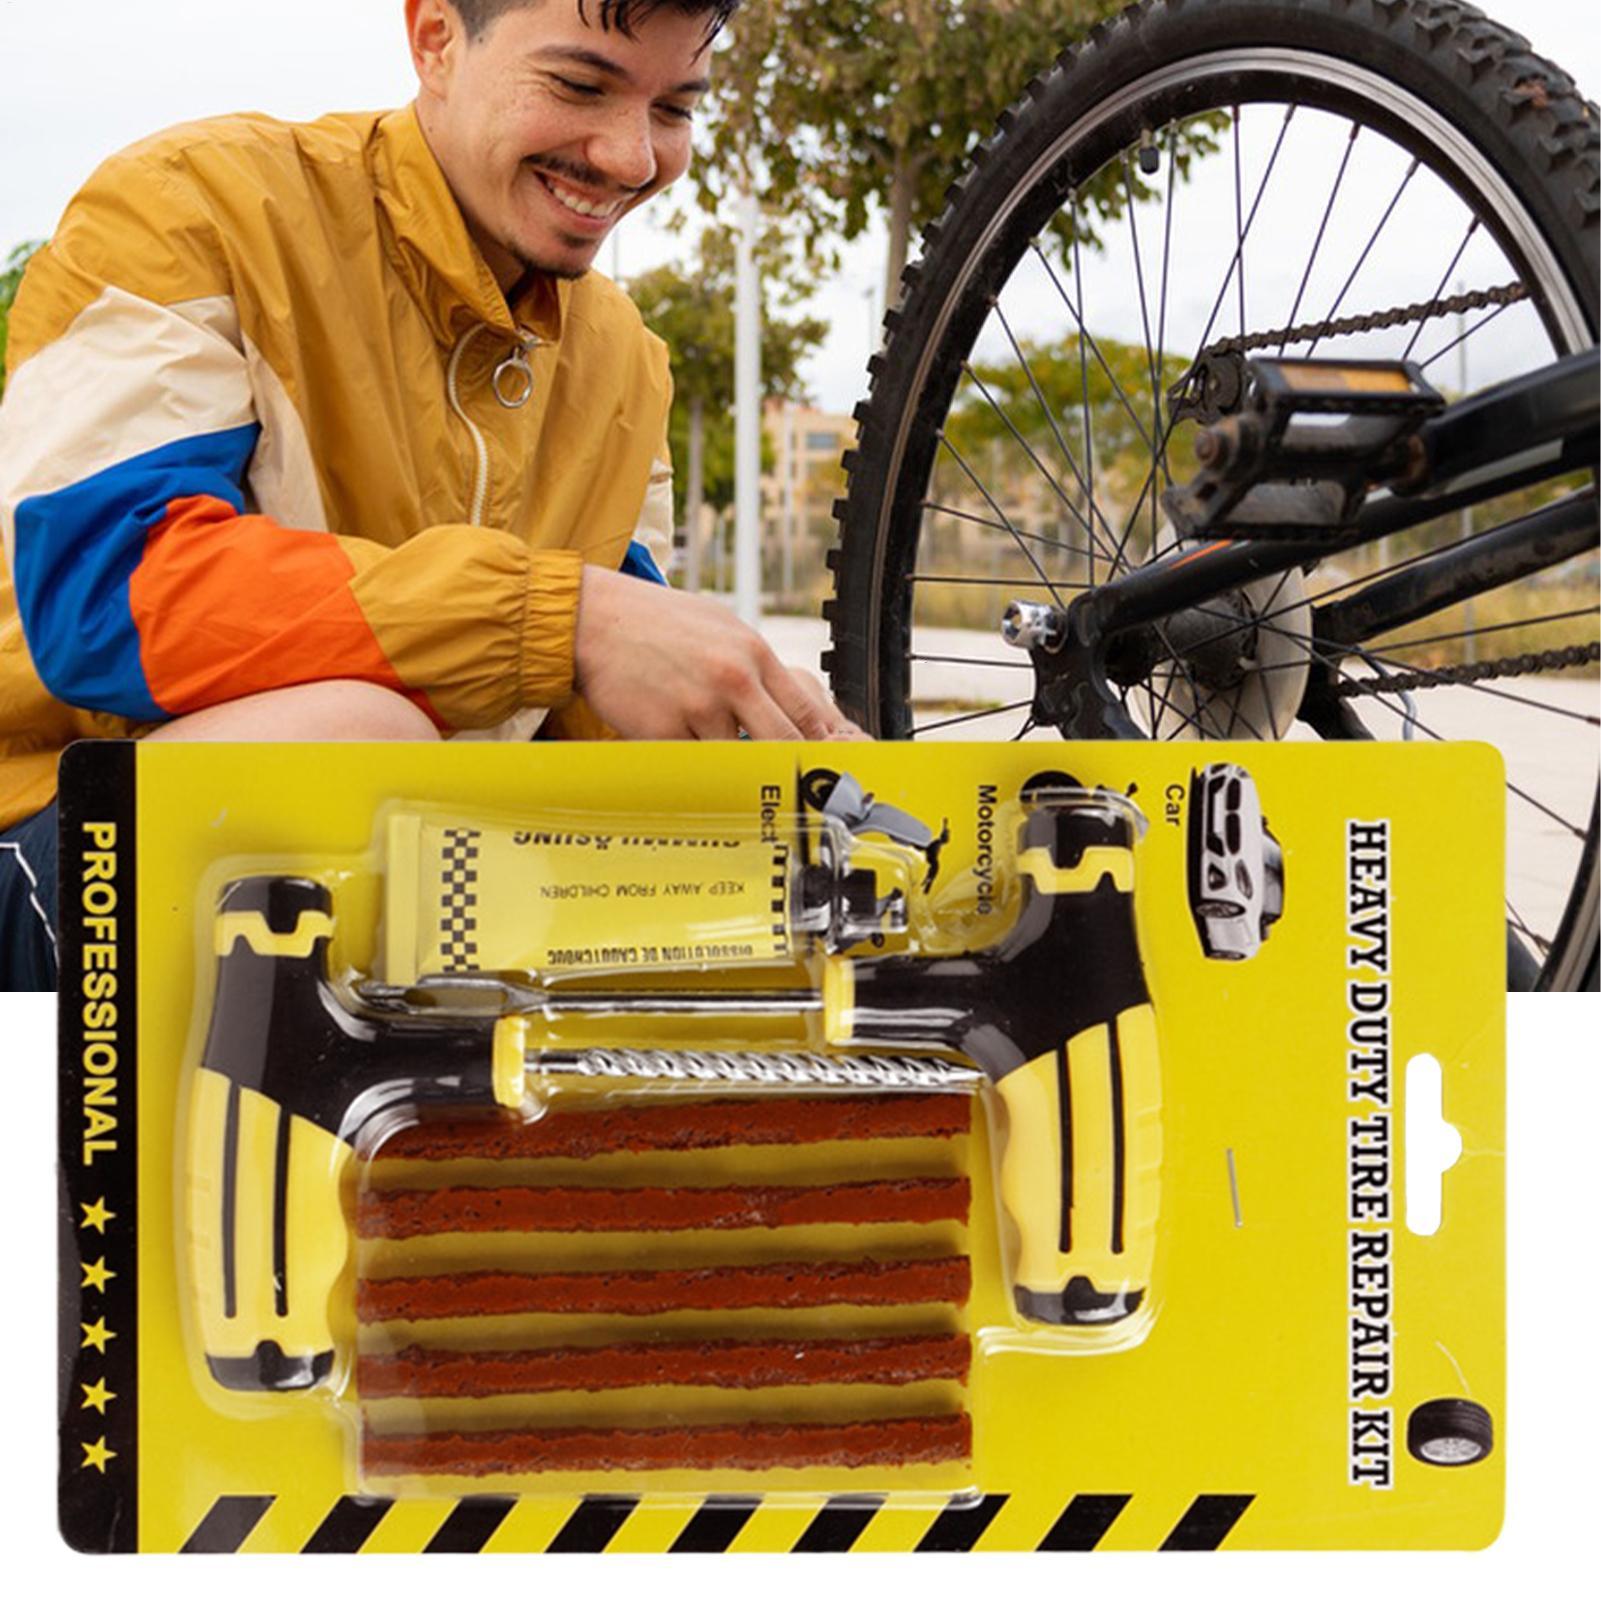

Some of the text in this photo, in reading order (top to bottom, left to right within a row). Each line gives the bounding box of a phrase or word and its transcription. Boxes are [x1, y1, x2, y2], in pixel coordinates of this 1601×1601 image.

[973, 784, 998, 915] Motorcycle
[1164, 783, 1185, 827] Car
[540, 880, 745, 899] KEEP AWAY FROM CHILDREN
[81, 821, 118, 1166] PROFESSIONAL
[1349, 822, 1390, 1486] HEAVY DUTY TIRE REPAIR KIT
